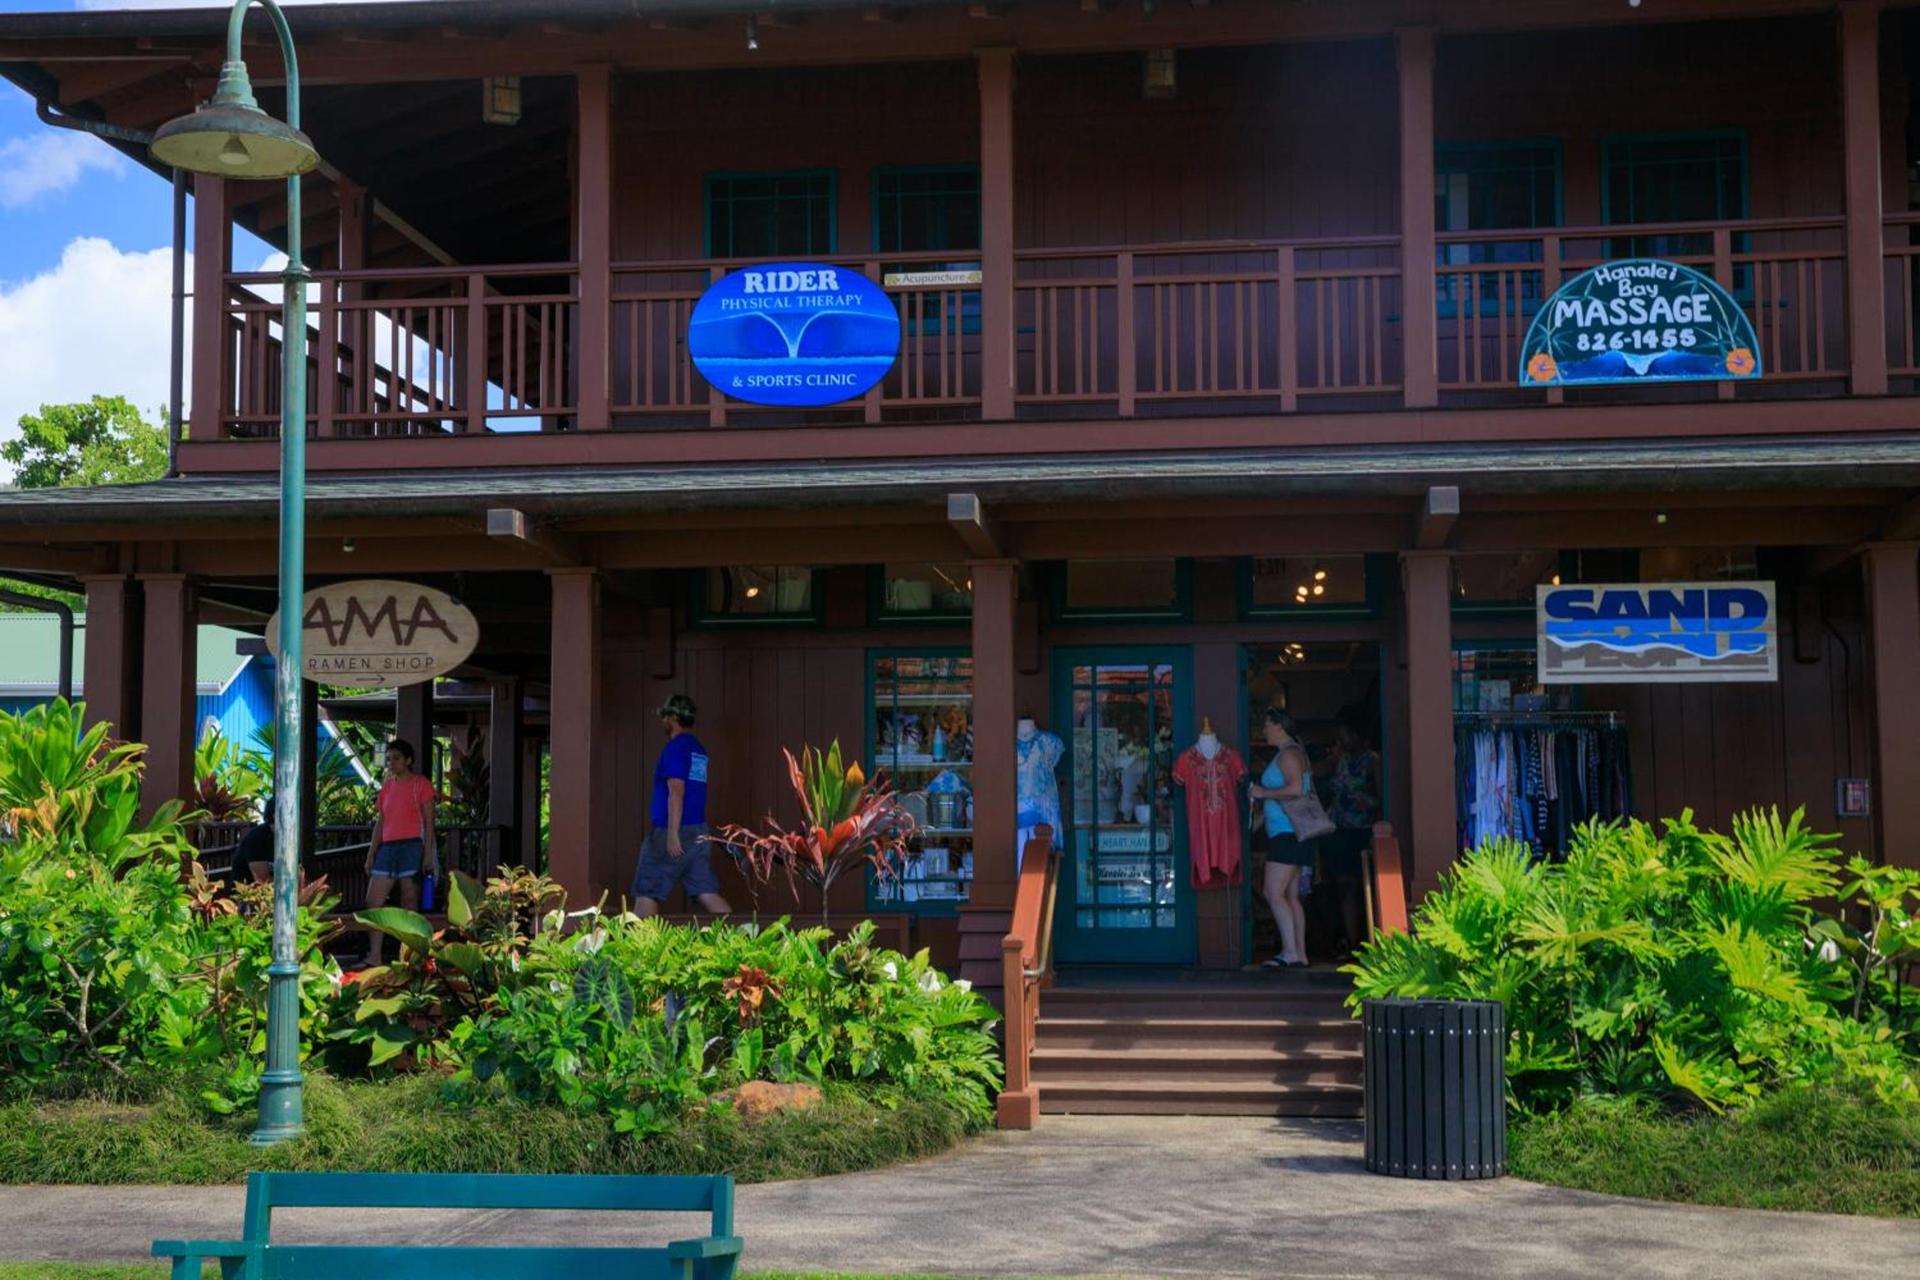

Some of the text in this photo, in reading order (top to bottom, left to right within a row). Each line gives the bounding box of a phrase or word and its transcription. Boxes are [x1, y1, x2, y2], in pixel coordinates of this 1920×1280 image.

[744, 270, 840, 294] RIDER
[902, 272, 966, 284] Acupuncture
[1595, 263, 1678, 286] Hanalei
[1618, 279, 1659, 298] Bay
[721, 294, 863, 310] PHYSICAL THERAPY
[1554, 293, 1713, 328] MASSAGE
[1576, 328, 1697, 351] 826-1455
[732, 373, 857, 387] & SPORTS CLINIC
[302, 596, 459, 647] AMA
[1544, 588, 1769, 634] SAND
[308, 657, 435, 670] RAMEN SHOP
